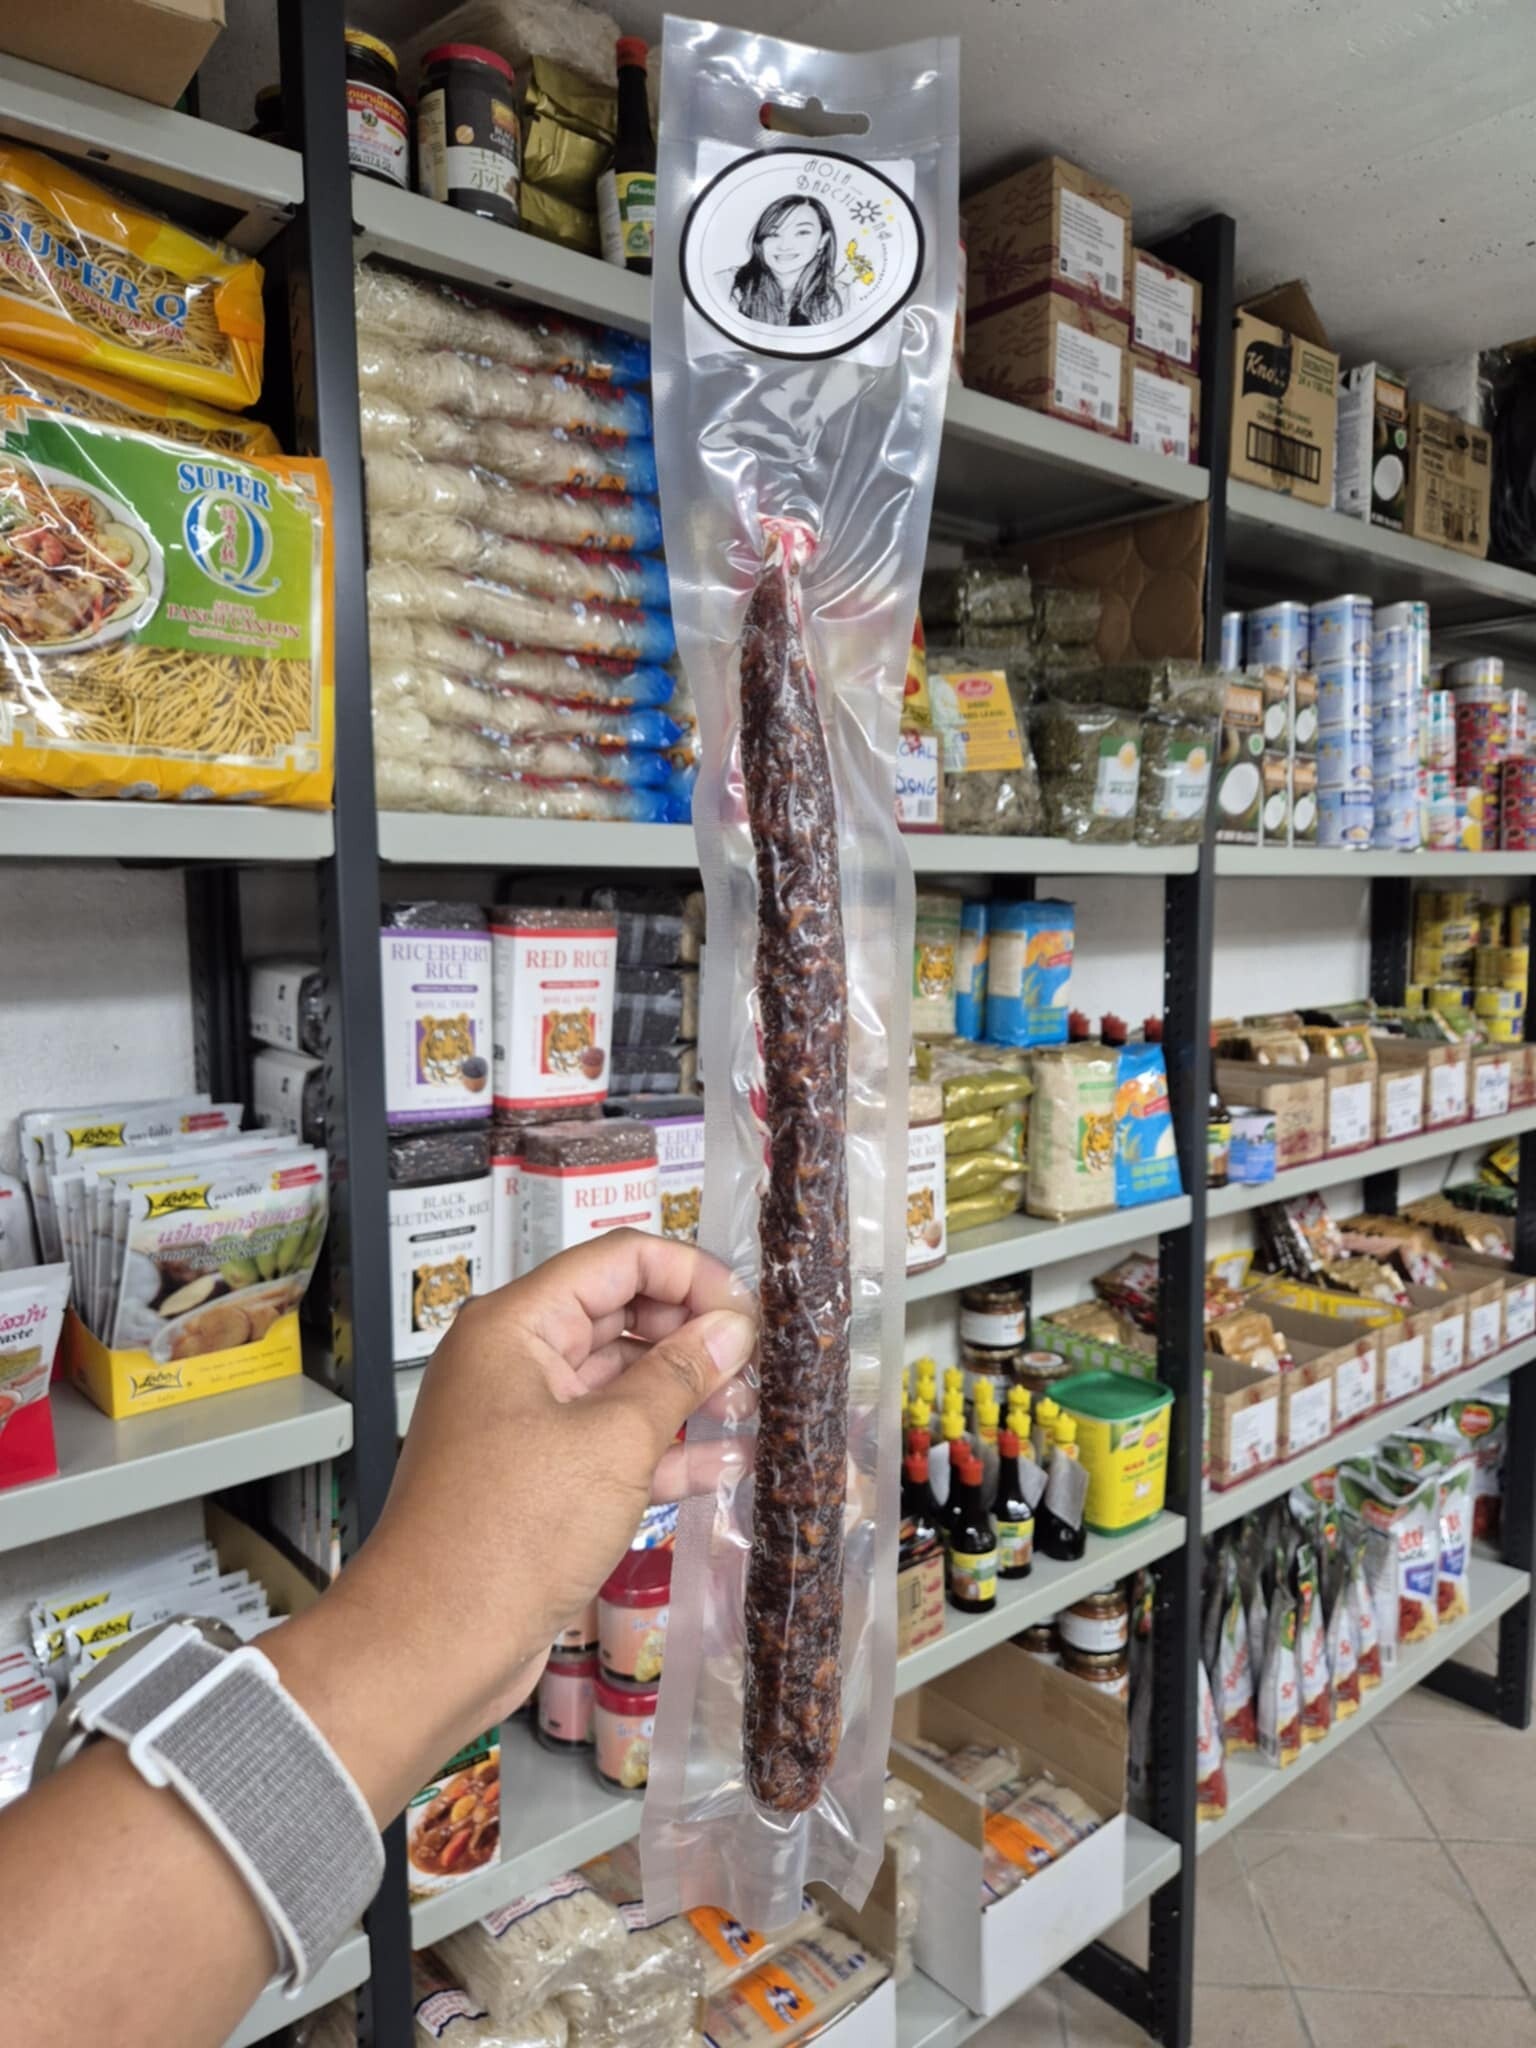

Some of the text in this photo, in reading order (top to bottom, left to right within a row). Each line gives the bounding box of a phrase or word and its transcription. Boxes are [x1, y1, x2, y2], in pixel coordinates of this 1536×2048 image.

[0, 211, 188, 328] SUPER Q
[177, 460, 273, 512] SUPER
[182, 489, 282, 598] Q
[525, 949, 567, 970] RED
[574, 1184, 618, 1208] RED
[623, 1178, 657, 1203] RIC
[0, 1327, 35, 1345] aste
